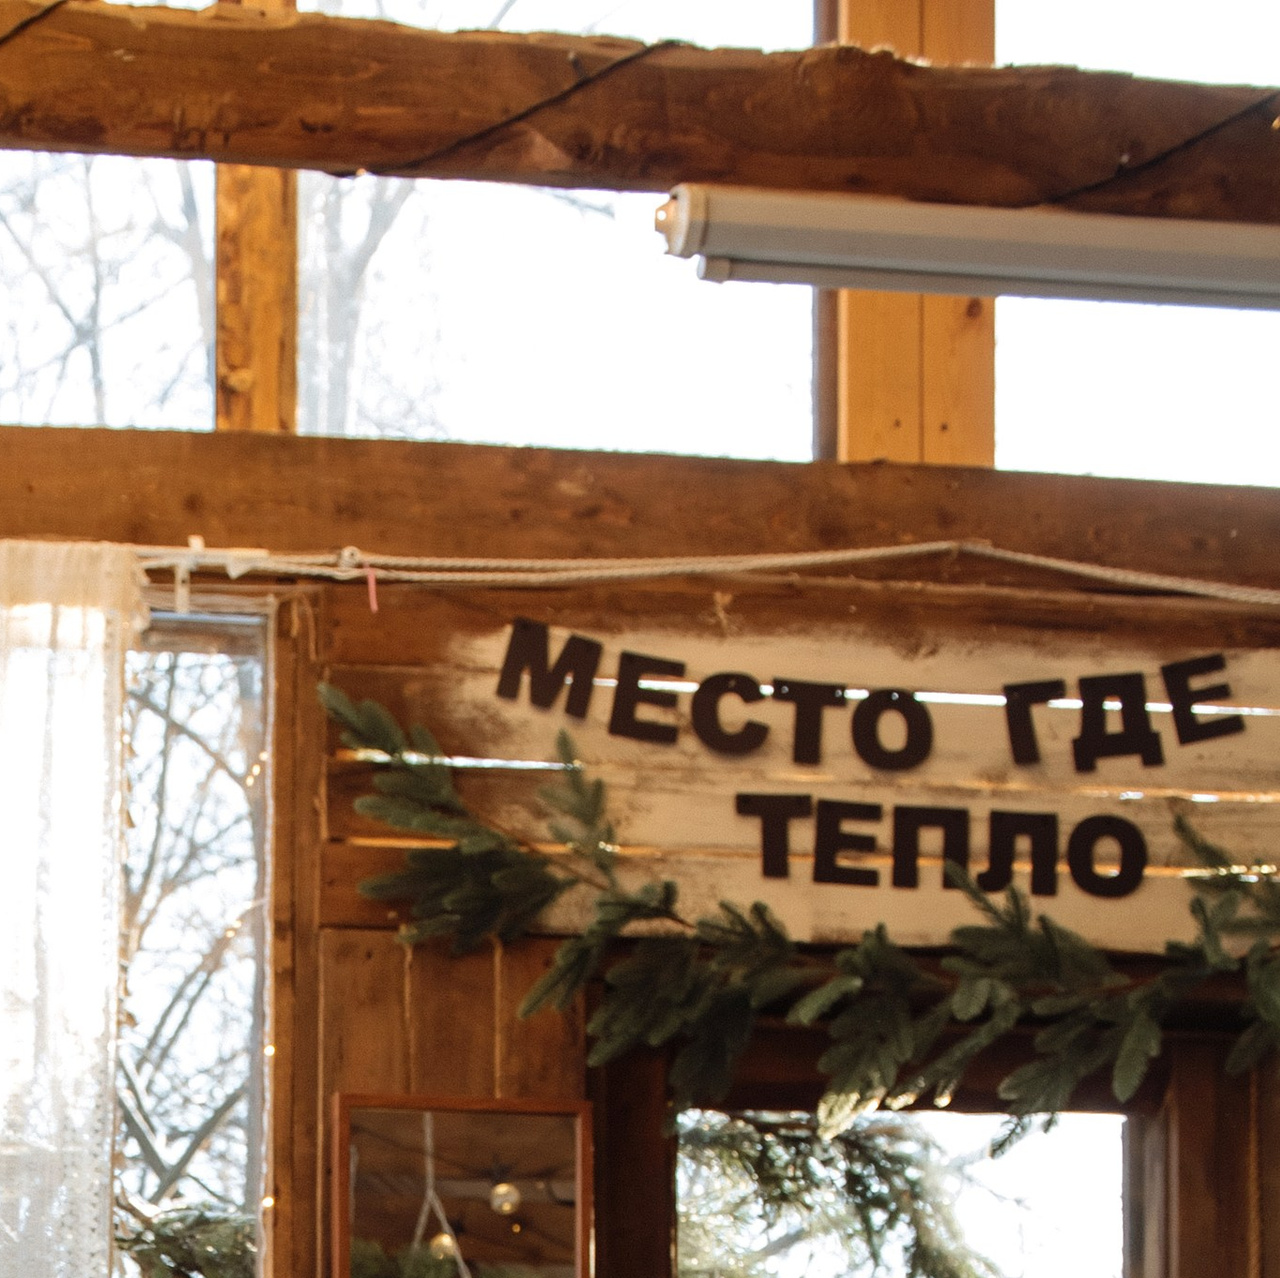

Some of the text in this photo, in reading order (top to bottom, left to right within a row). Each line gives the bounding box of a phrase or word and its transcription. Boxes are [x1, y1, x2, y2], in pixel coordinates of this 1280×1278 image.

[497, 619, 1244, 772] МЕСТО ГДЕ
[736, 793, 1147, 898] ТЕПЛО
